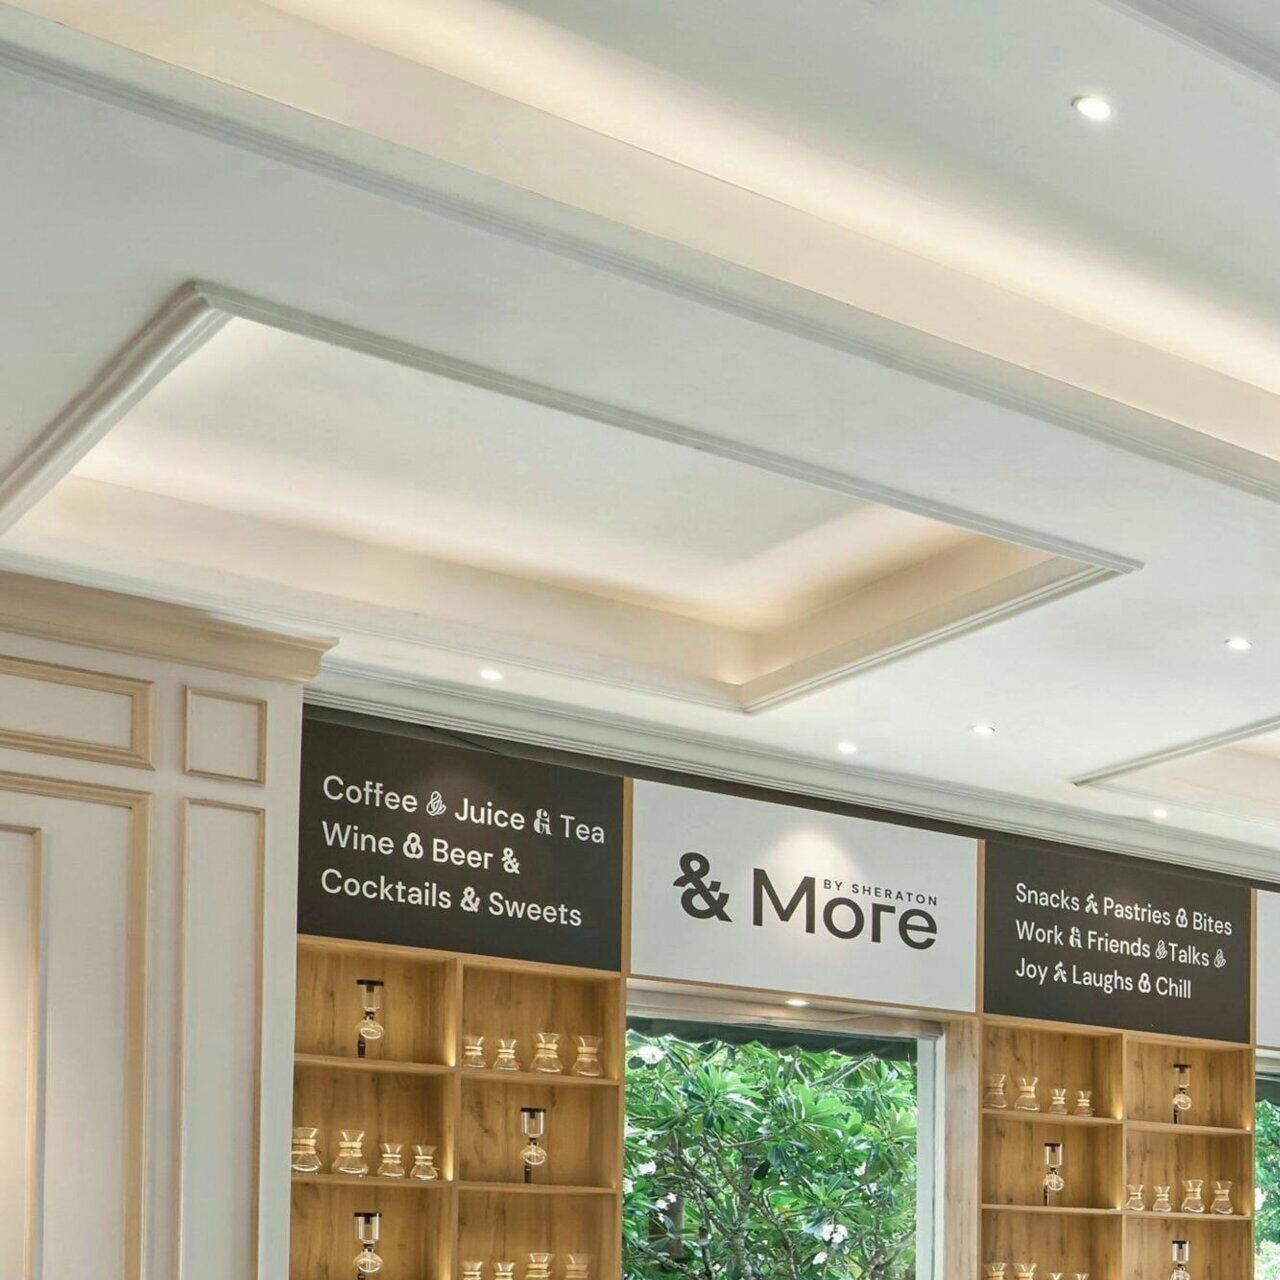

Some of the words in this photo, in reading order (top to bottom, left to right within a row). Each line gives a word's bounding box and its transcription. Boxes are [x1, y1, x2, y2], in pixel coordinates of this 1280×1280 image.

[323, 775, 418, 813] Coffee
[454, 797, 525, 831] Juice
[559, 814, 606, 845] Tea
[321, 820, 395, 855] Wine
[432, 837, 494, 870] Beer
[321, 868, 452, 909] Cocktails
[488, 891, 582, 928] Sweets
[752, 867, 938, 950] More
[823, 879, 843, 891] BY
[851, 883, 937, 906] SHERATON
[1015, 882, 1080, 912] Snacks
[1103, 897, 1172, 926] Pastries
[1192, 911, 1233, 936] Bites
[1015, 919, 1064, 946] Work
[1087, 929, 1151, 959] Friends
[1168, 941, 1210, 968] Talks
[1015, 957, 1049, 986] Joy
[1072, 964, 1134, 995] Laughs
[1155, 976, 1192, 999] Chill
